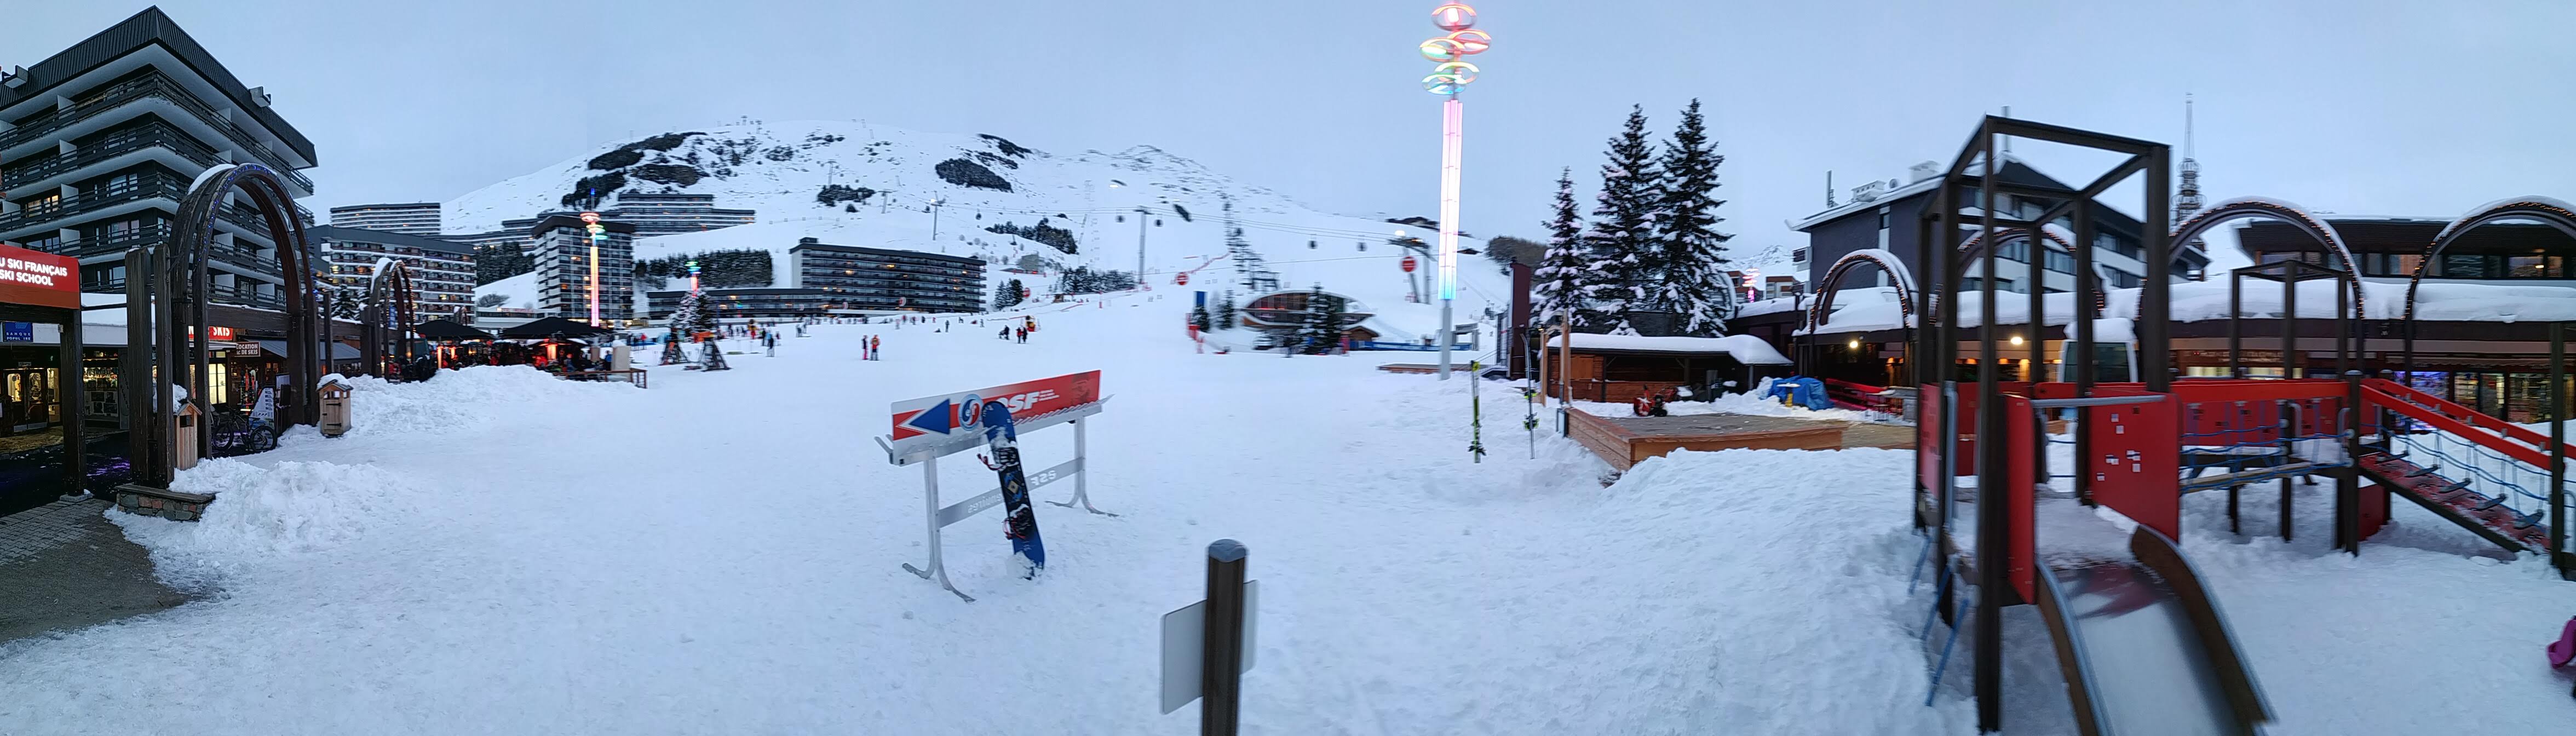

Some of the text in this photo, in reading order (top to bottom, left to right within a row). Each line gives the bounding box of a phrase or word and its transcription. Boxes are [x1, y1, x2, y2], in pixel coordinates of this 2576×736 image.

[8, 258, 22, 270] SKI
[25, 261, 67, 277] FRANÇAIS
[0, 269, 54, 286] SKI SCHOOL
[213, 327, 230, 337] SKIS
